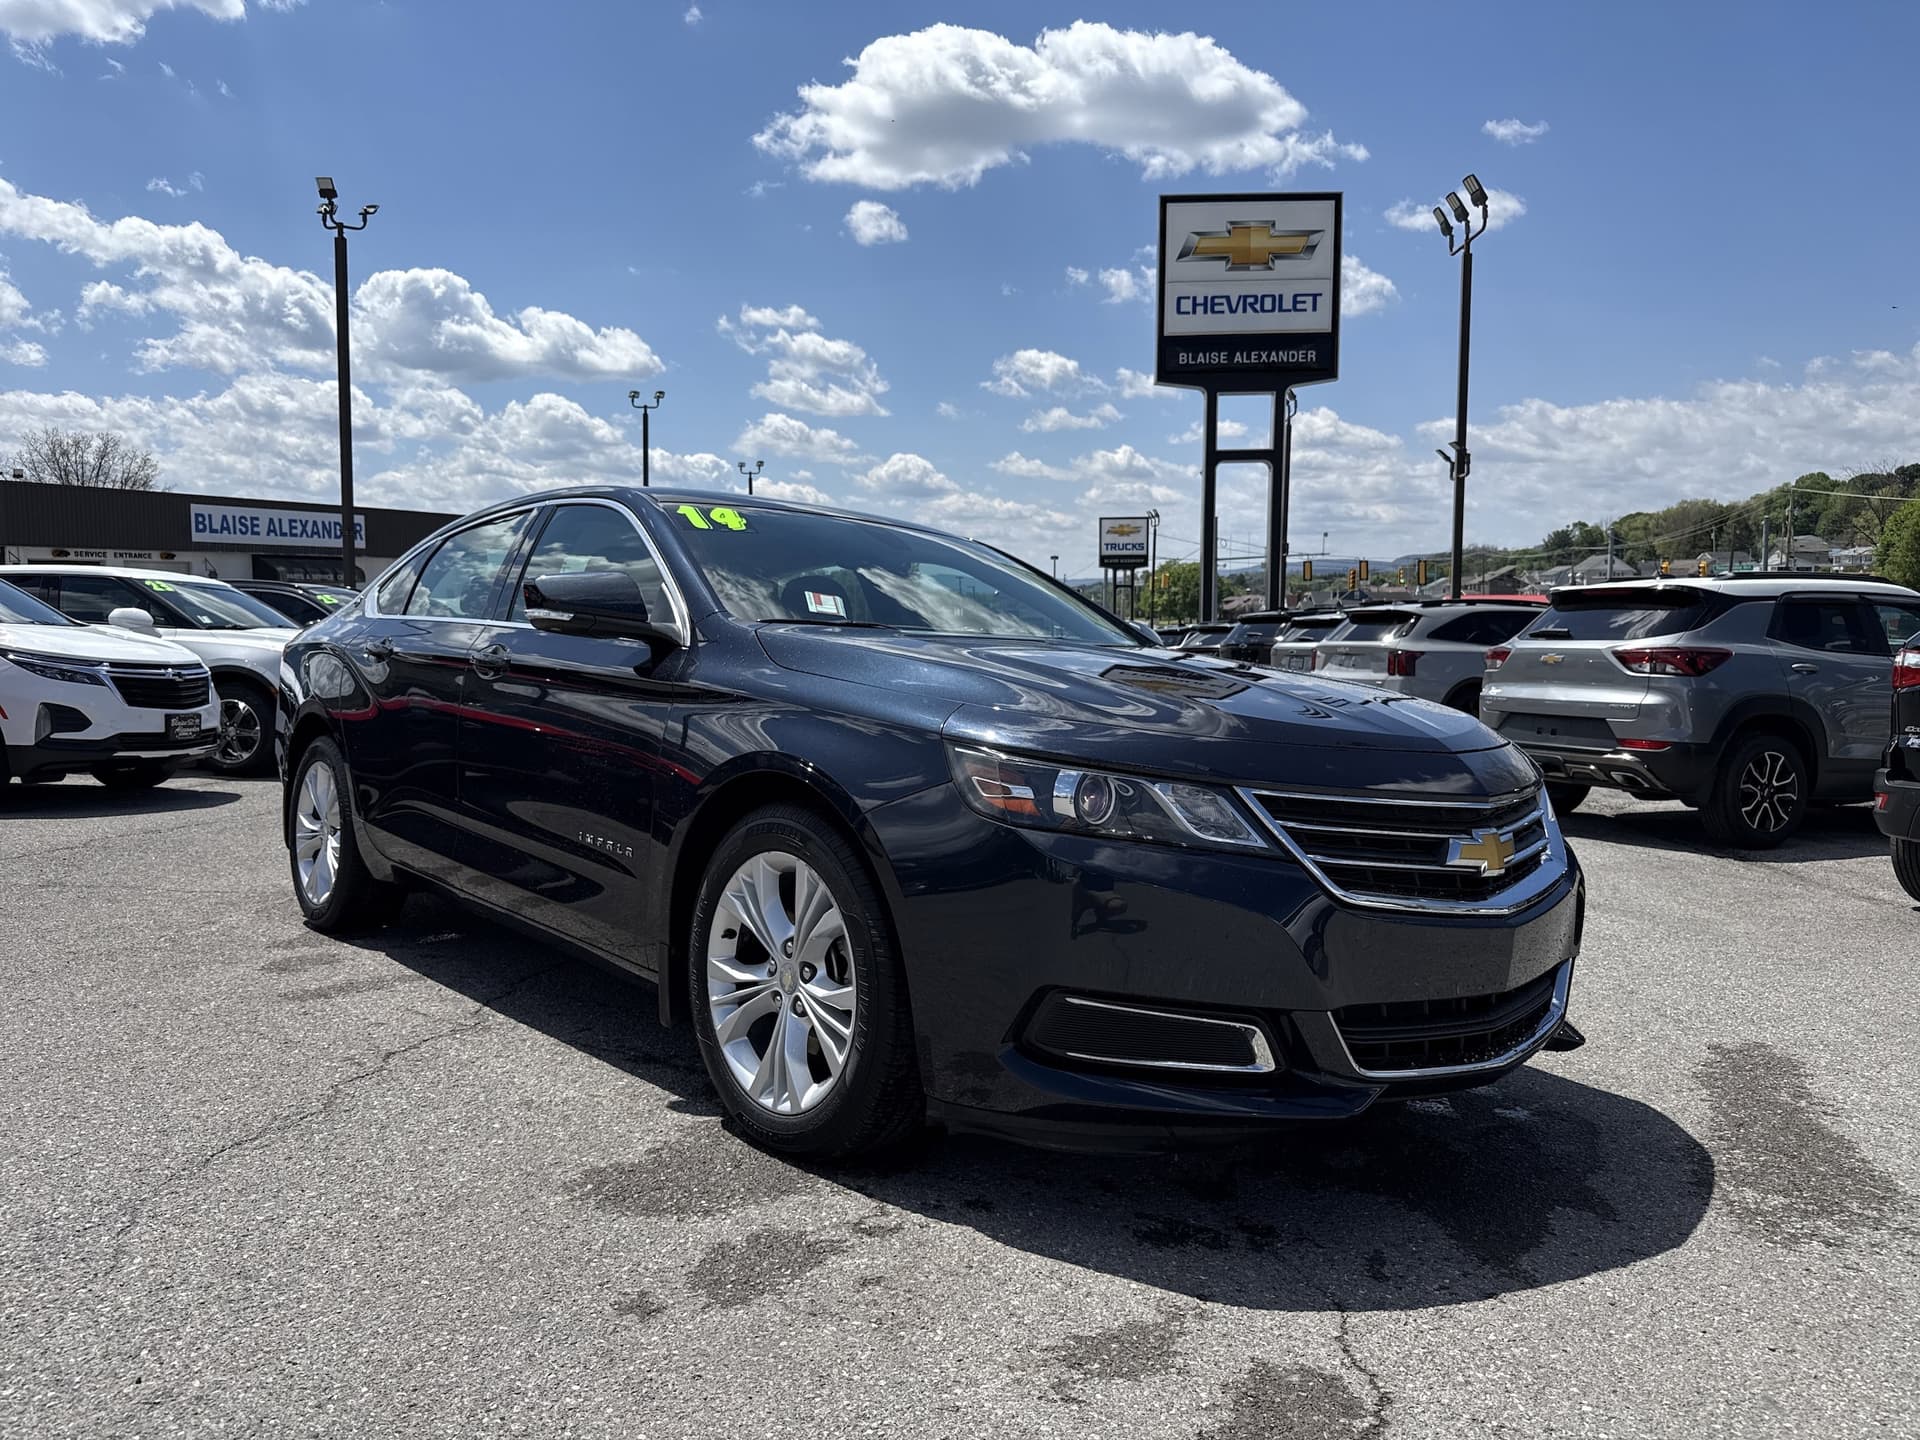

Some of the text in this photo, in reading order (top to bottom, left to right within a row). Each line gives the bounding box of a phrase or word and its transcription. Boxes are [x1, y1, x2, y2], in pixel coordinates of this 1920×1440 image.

[1175, 293, 1323, 315] CHEVROLET
[1178, 350, 1317, 365] BLAISE ALEXANDER
[194, 512, 364, 541] BLAISE ALEXANDR
[676, 505, 747, 531] 14
[74, 550, 153, 560] SERVICE ENTRANCE
[1103, 542, 1145, 551] TRUCKS
[578, 831, 633, 858] IMPALA
